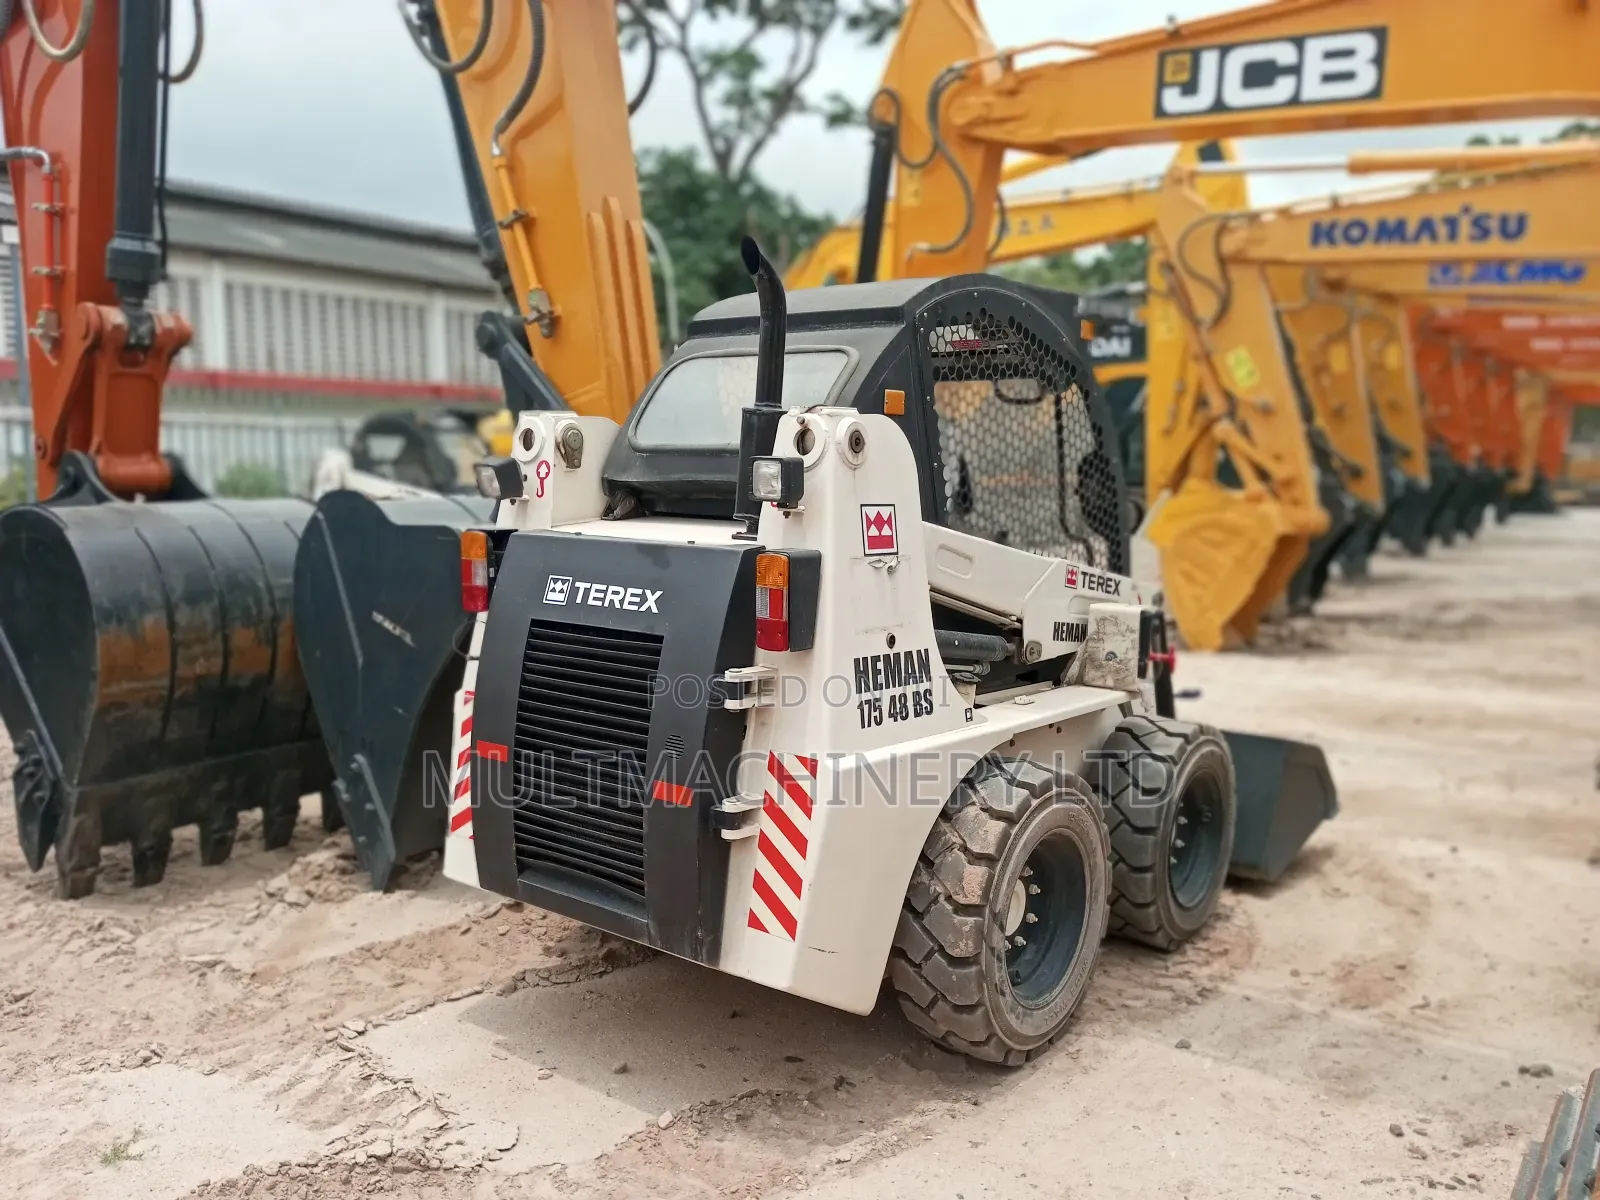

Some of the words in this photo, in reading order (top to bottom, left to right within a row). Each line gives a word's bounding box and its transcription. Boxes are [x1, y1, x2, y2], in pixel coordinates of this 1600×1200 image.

[1161, 31, 1379, 115] JCB
[1309, 203, 1528, 248] KOMATSU
[574, 581, 664, 614] TEREX
[1080, 571, 1121, 597] TEREX
[1052, 621, 1089, 643] HEMAN
[853, 648, 932, 694] HEMAN
[857, 698, 884, 729] 175
[888, 692, 910, 723] 48
[912, 688, 934, 718] BS
